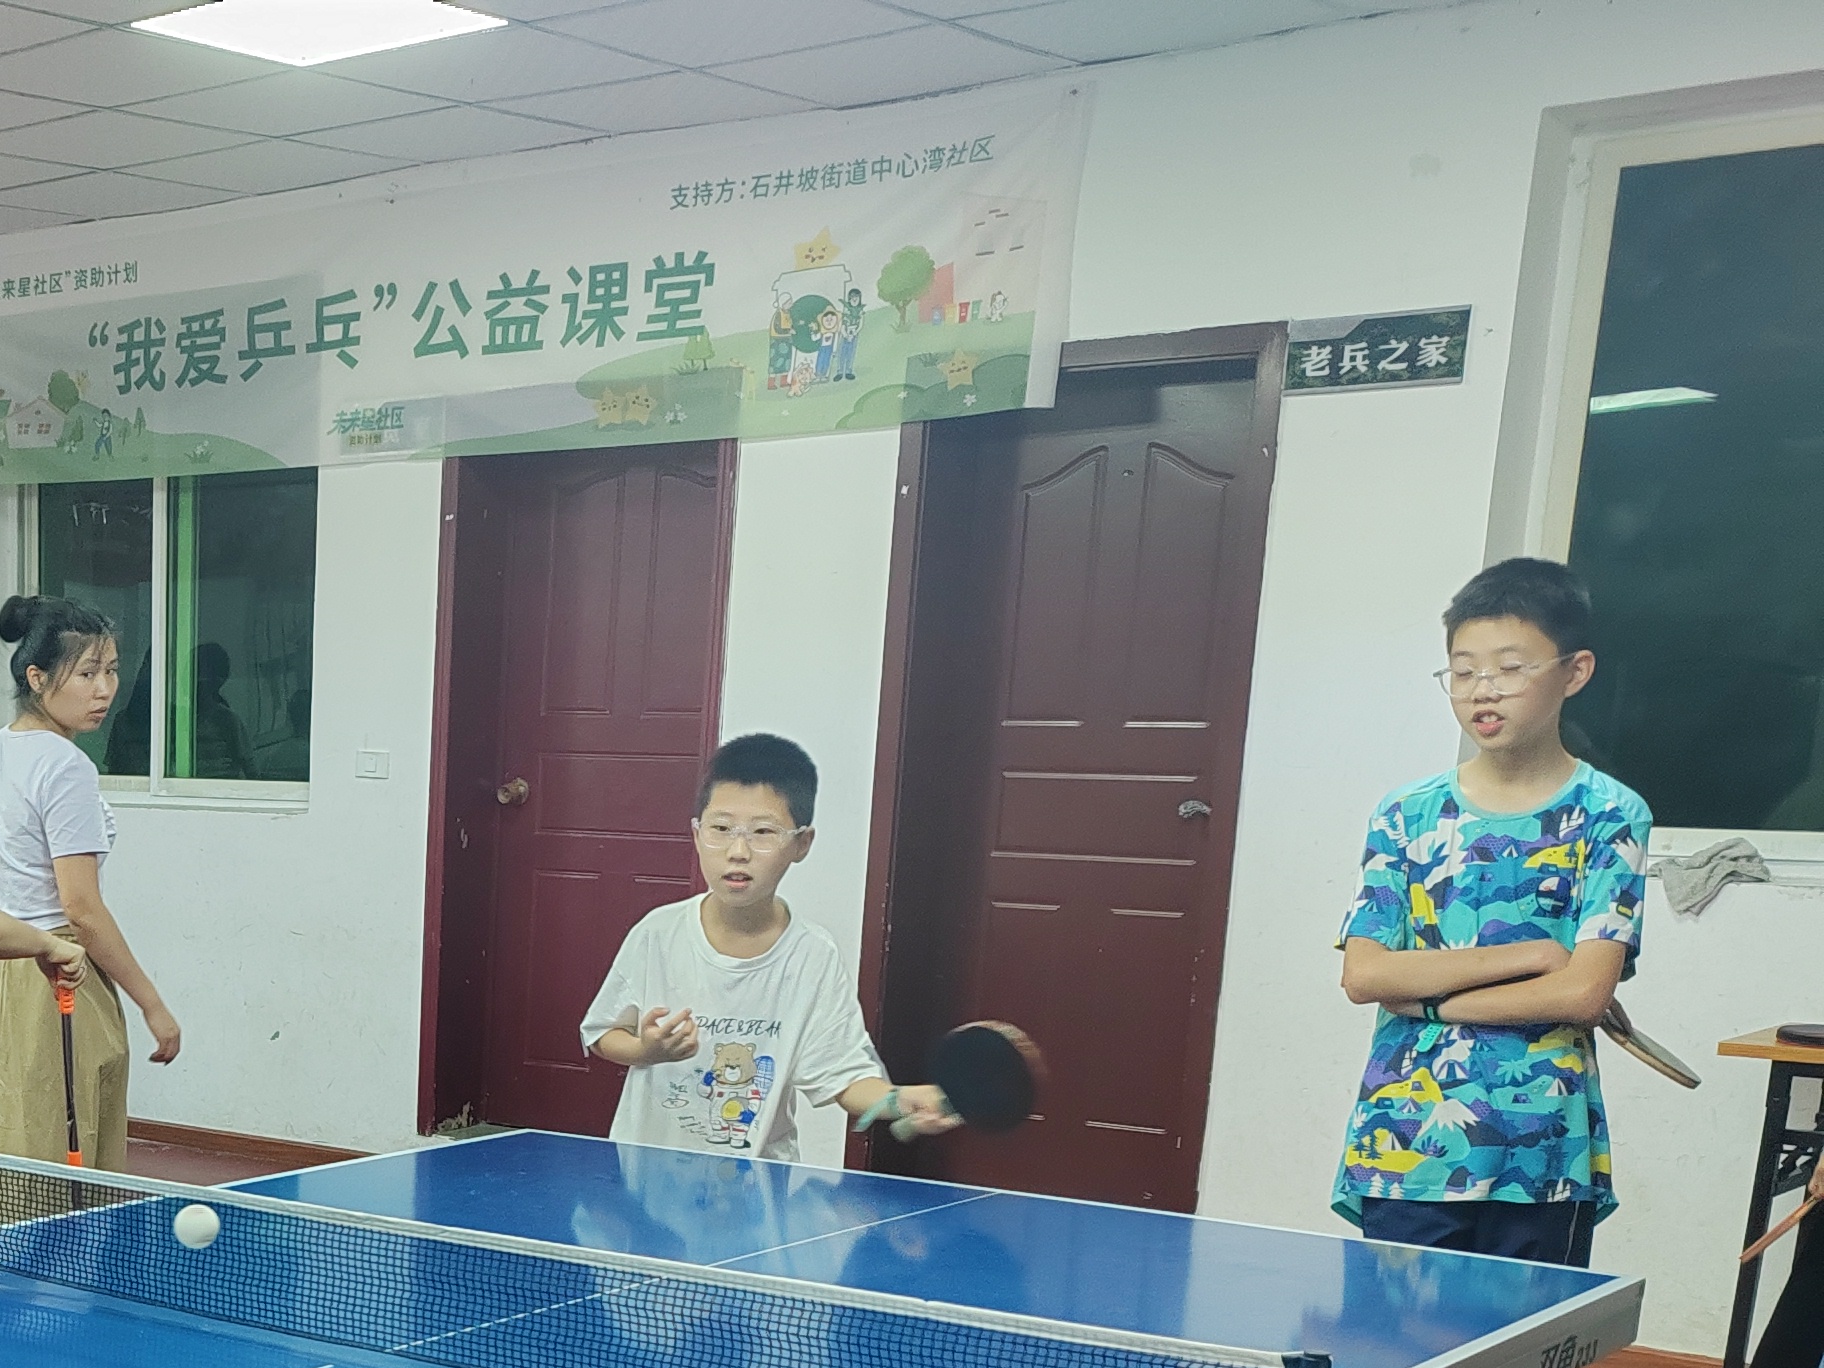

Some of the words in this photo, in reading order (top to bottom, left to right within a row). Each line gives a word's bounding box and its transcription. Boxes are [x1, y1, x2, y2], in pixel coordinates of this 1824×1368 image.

[87, 249, 717, 396] “我爱乒乓”公益课堂
[1300, 334, 1451, 377] 老兵之家
[326, 406, 405, 435] 未来星社区
